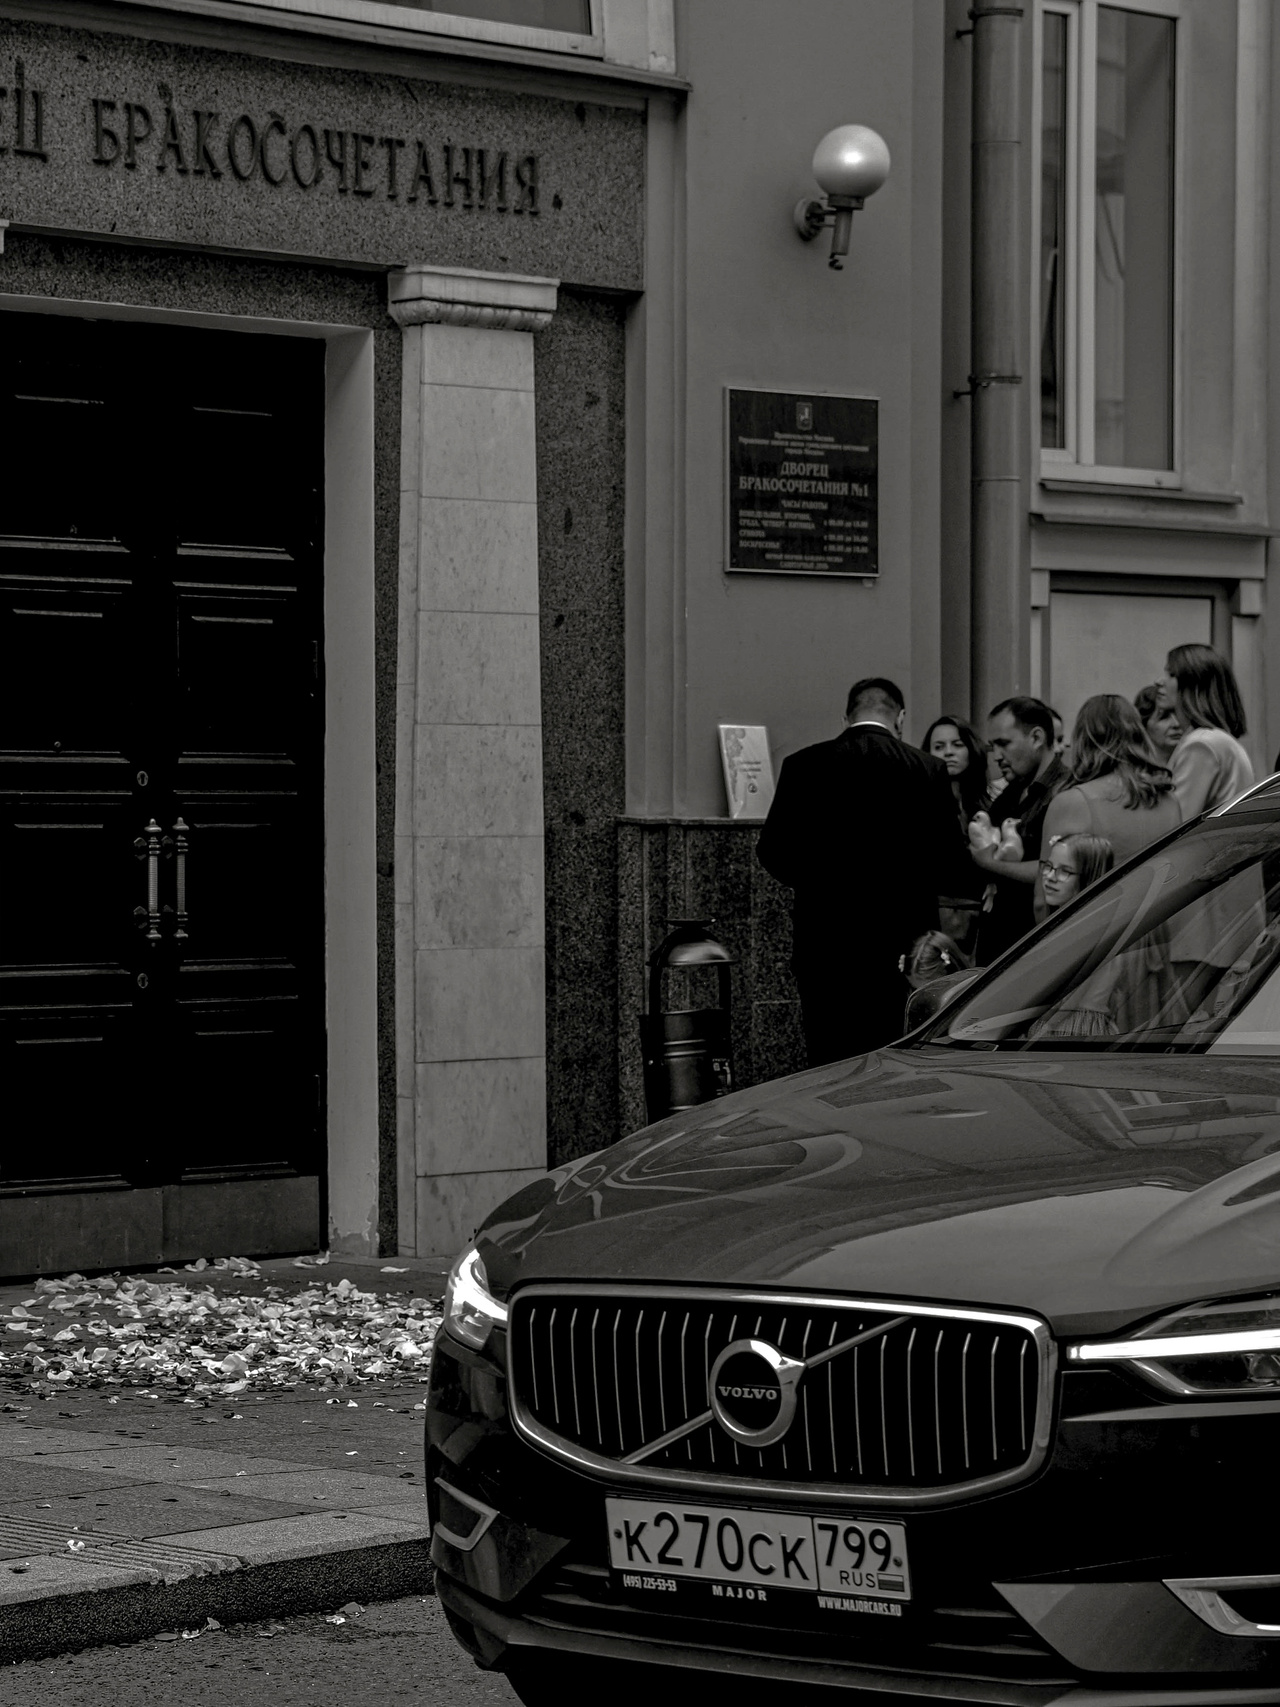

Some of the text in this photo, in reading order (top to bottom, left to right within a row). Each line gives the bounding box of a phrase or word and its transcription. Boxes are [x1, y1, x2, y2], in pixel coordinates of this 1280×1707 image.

[91, 96, 541, 215] БРАКОСОЧЕТАНИЯ
[781, 462, 829, 478] ДВОРЕЦ
[739, 476, 849, 496] БРАКОСОЧЕТАНИЯ
[718, 1385, 778, 1400] VOLVO
[817, 1522, 893, 1572] 799
[622, 1573, 678, 1592] (495) 225-53-53
[840, 1570, 876, 1589] RUS
[711, 1584, 768, 1601] MAJOR
[816, 1595, 902, 1617] WWW.MAJORCARS.RU
